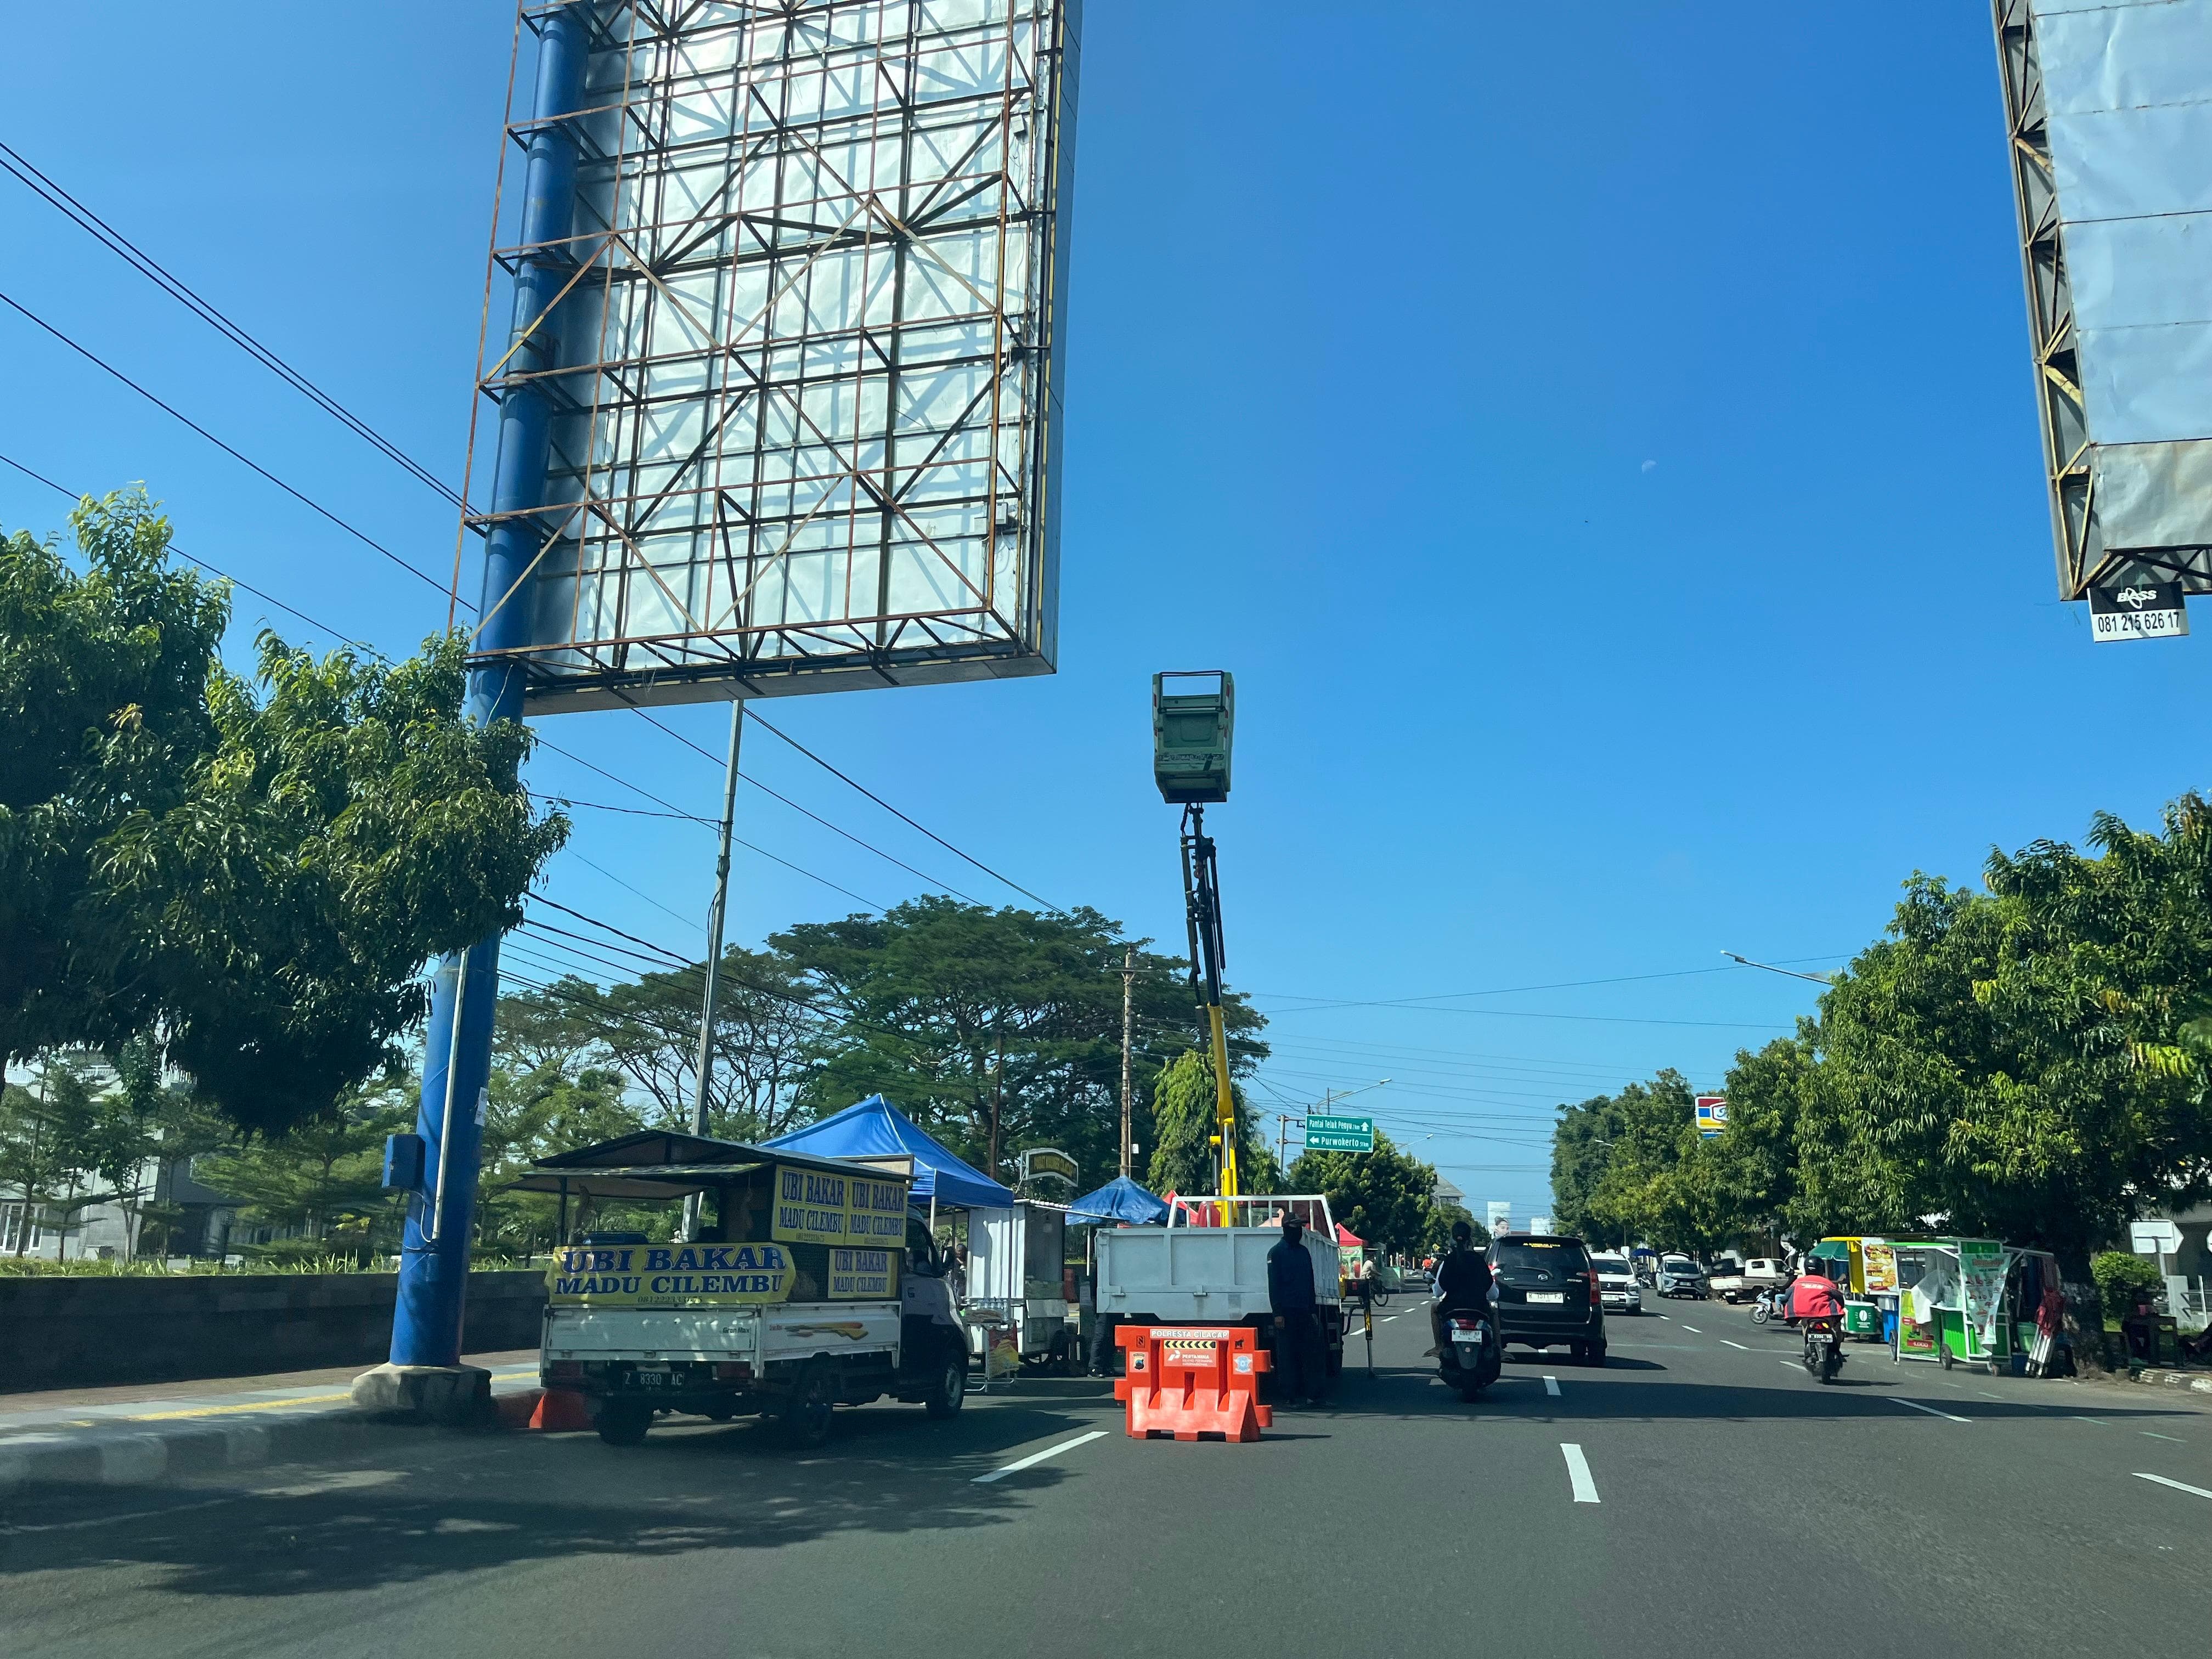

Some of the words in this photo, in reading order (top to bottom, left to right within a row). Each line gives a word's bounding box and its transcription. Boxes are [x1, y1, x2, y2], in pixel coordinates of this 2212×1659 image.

[2098, 616, 2117, 633] 081
[2121, 614, 2141, 631] 215
[2144, 612, 2165, 629] 626
[2168, 612, 2180, 628] 17
[1309, 1119, 1324, 1128] Pantai
[1338, 1120, 1352, 1131] Penyu
[1321, 1136, 1359, 1147] Purwokerto
[782, 1170, 804, 1203] UBI
[805, 1173, 844, 1207] BAKAR
[852, 1181, 870, 1210] UBI
[872, 1183, 904, 1212] BAKAR
[779, 1206, 805, 1230] MADU
[806, 1209, 844, 1233] CILEMBU
[850, 1214, 871, 1234] MADU
[872, 1216, 904, 1237] CILEMBU
[561, 1249, 634, 1274] UBI
[642, 1245, 788, 1272] BAKAR
[834, 1250, 853, 1273] UBI
[855, 1251, 887, 1273] BAKAR
[554, 1276, 642, 1295] MADU
[650, 1274, 784, 1293] CILEMBU
[833, 1276, 855, 1292] MADU
[857, 1277, 887, 1293] CILEMBU
[1193, 1330, 1228, 1339] CILACAP
